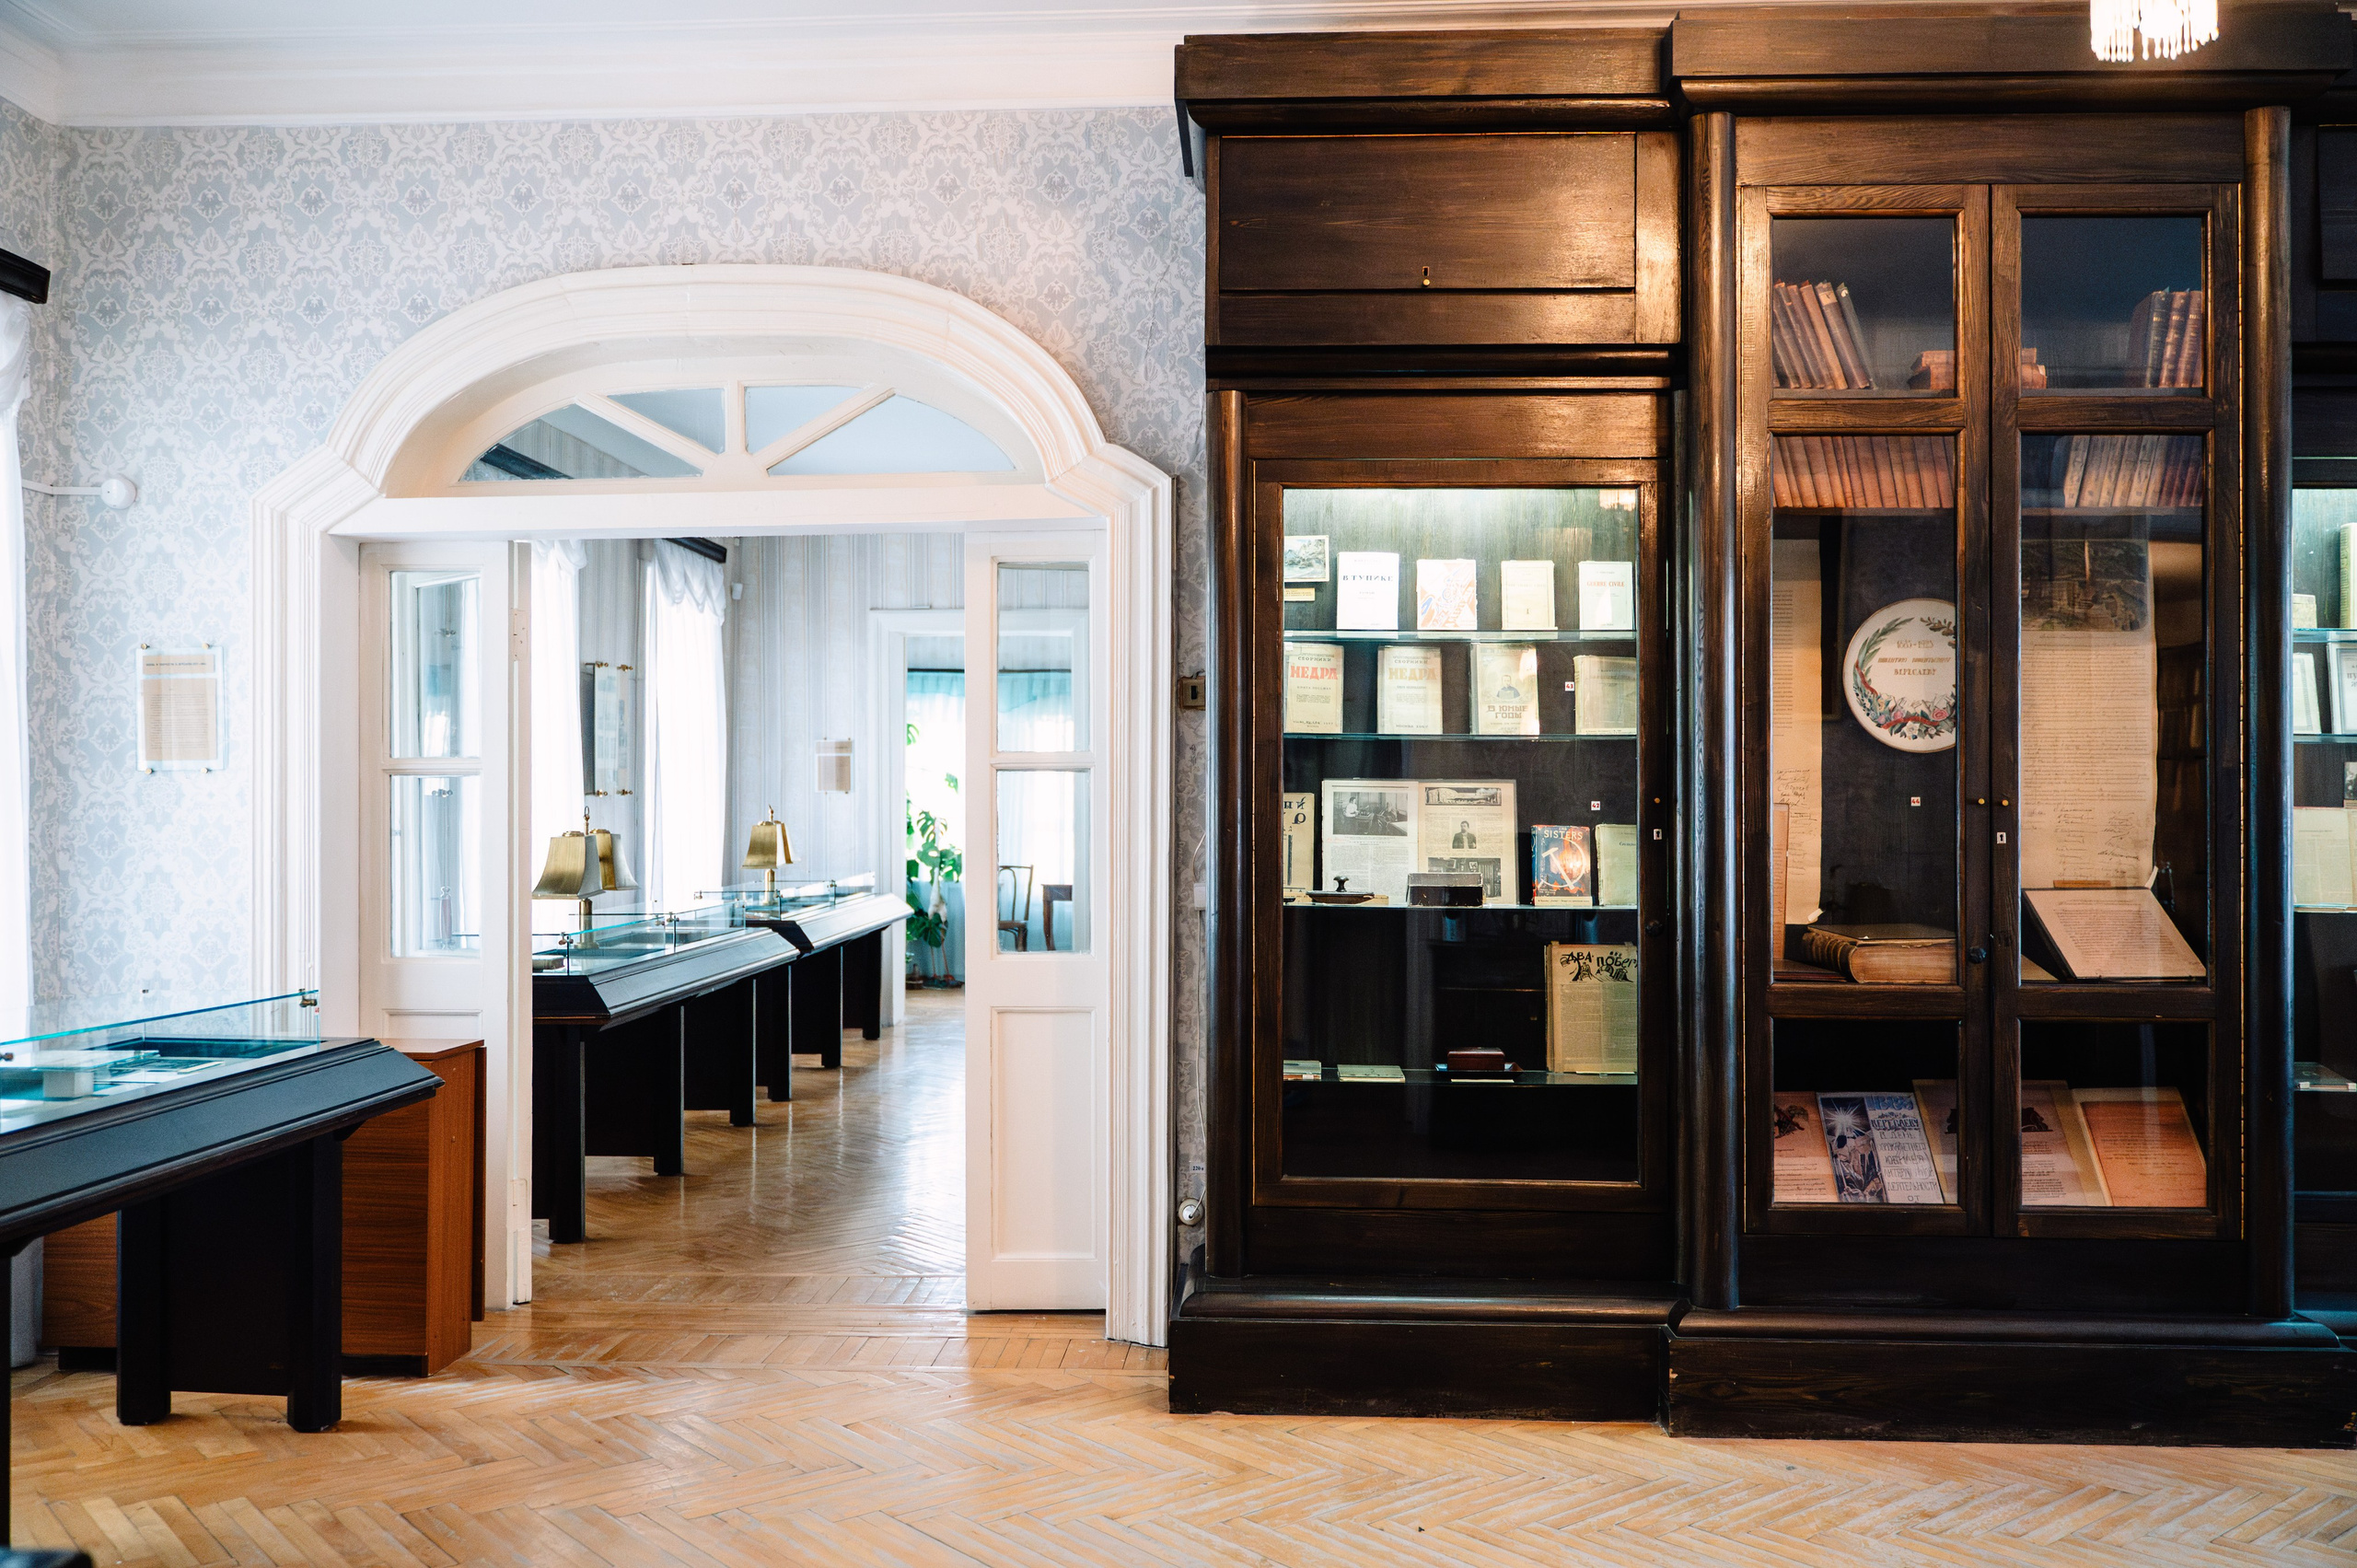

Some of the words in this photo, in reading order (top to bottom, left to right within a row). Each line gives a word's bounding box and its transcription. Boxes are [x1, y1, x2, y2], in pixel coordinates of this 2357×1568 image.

[1290, 665, 1339, 680] НЕДРА
[1387, 668, 1437, 681] НЕДРА
[1543, 830, 1584, 840] SISTERS
